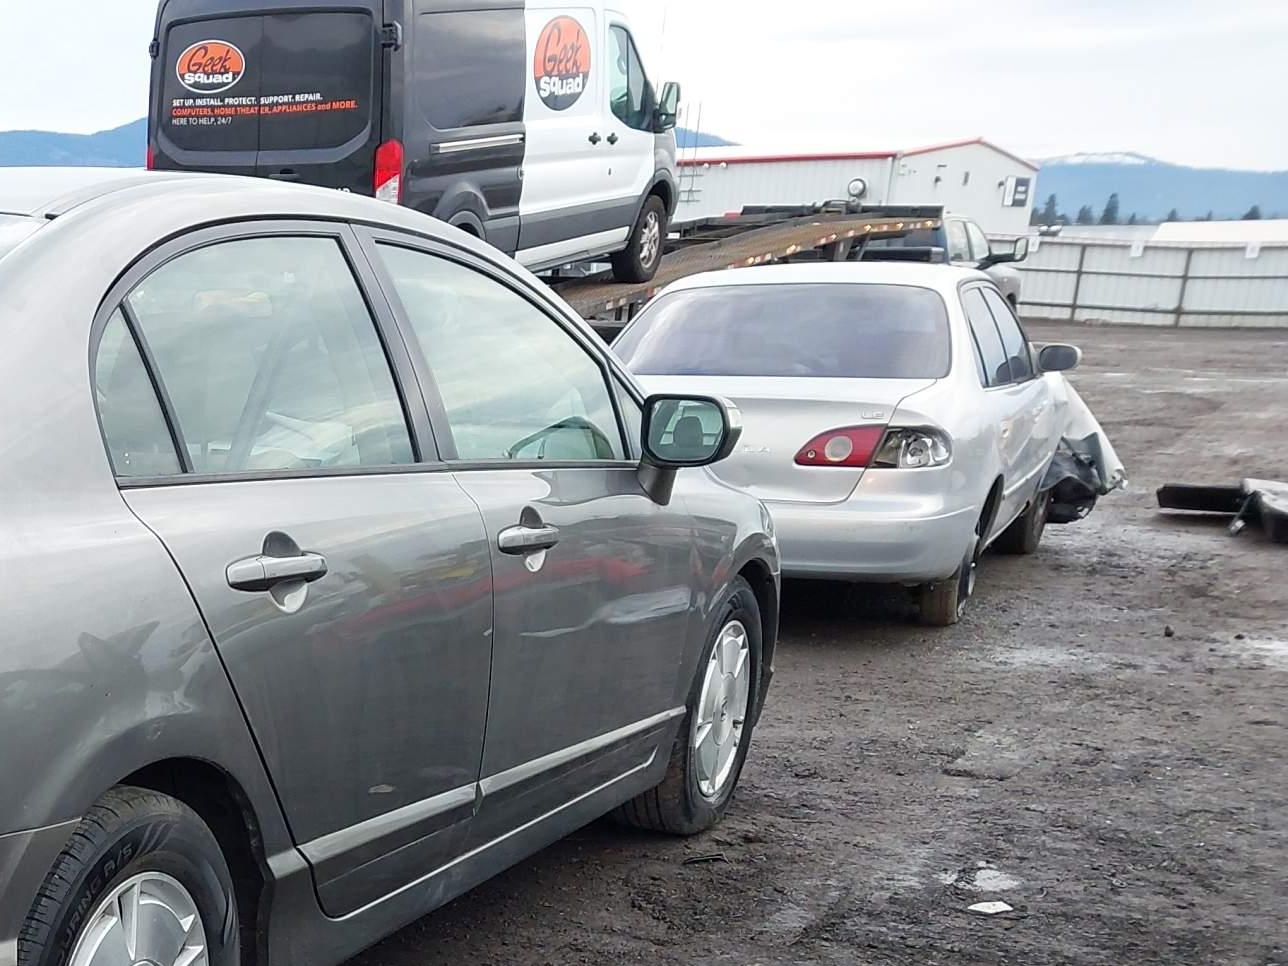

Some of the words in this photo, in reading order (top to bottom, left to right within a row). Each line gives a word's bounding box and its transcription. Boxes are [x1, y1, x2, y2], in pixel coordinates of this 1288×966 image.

[187, 45, 232, 73] Geek
[183, 71, 233, 84] Squad
[539, 73, 584, 98] Squad
[224, 97, 257, 105] PROTECT.
[260, 94, 294, 104] SUPPORT.
[295, 92, 323, 102] REPAIR.
[215, 106, 235, 115] HOME
[272, 103, 316, 113] APPLIANCES
[172, 117, 187, 125] HERE
[189, 117, 198, 125] TO
[217, 116, 232, 125] 24/7
